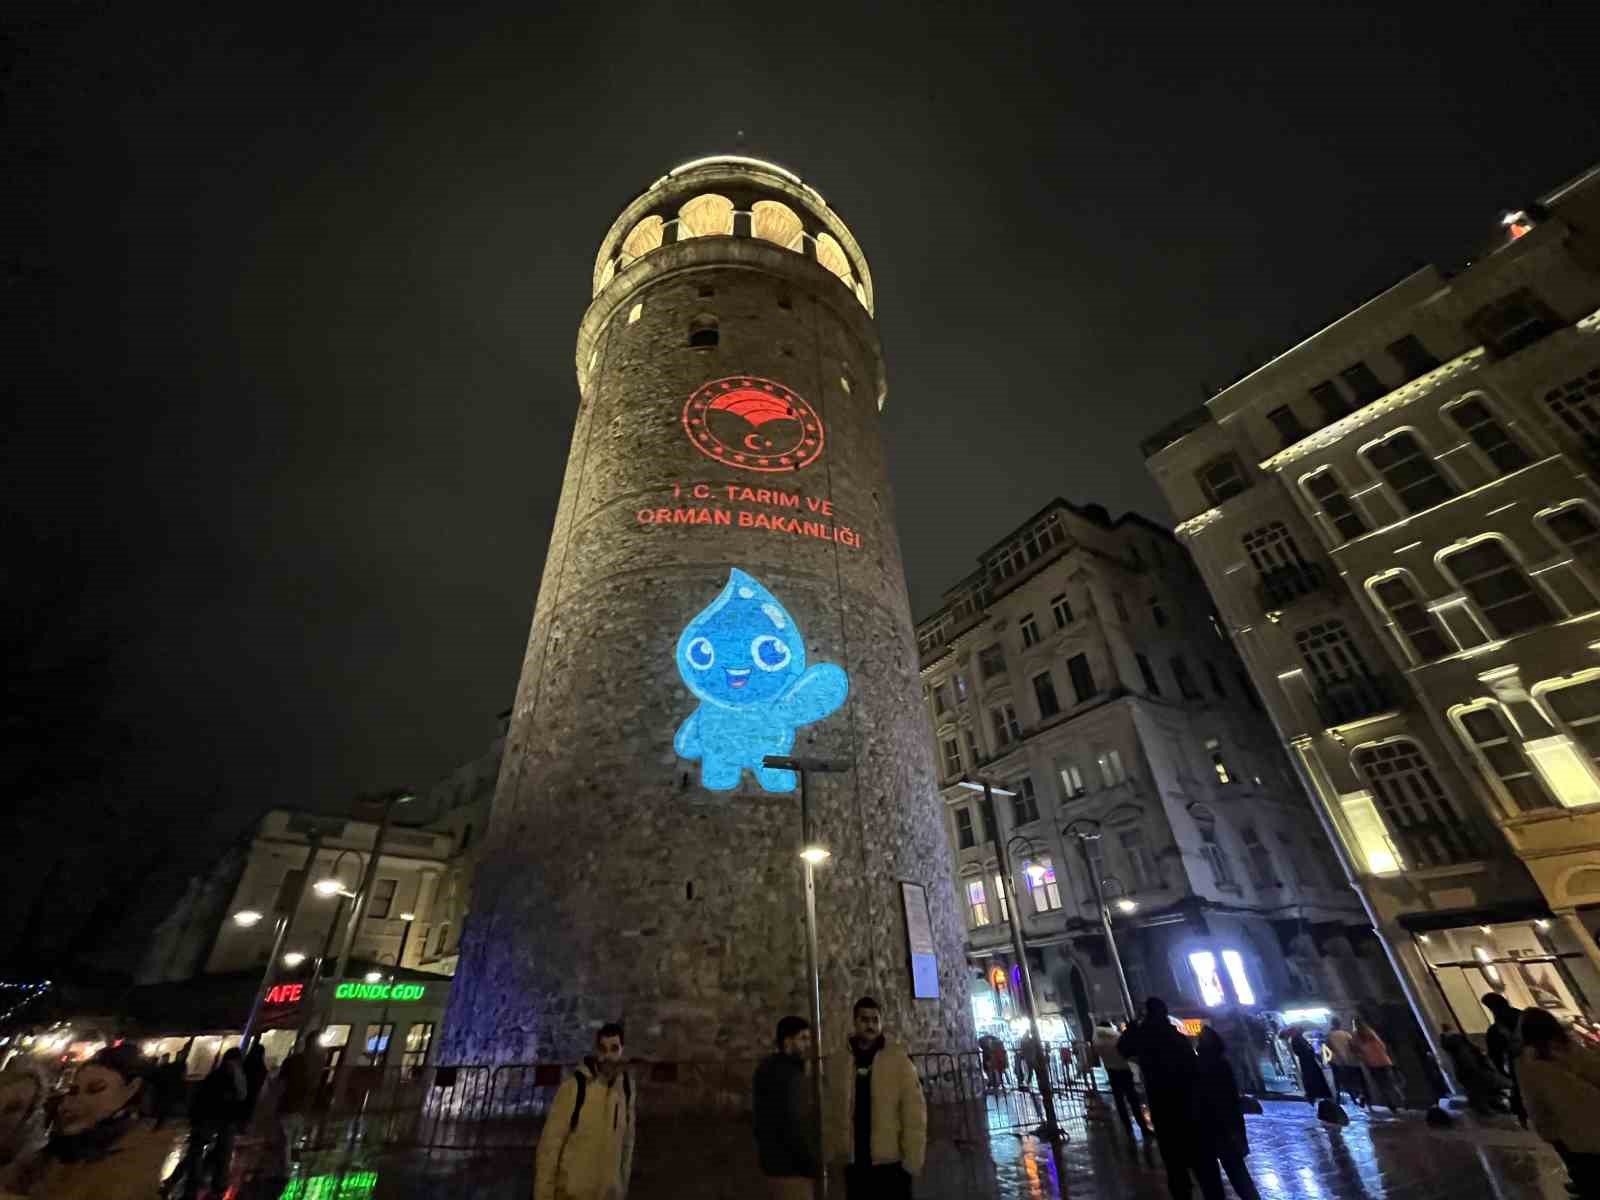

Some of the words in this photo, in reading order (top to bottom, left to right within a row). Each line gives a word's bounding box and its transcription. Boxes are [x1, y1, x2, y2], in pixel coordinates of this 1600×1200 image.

[727, 484, 800, 508] TARIM
[806, 496, 834, 516] VE
[636, 507, 732, 526] ORMAN
[738, 510, 862, 549] BAKANLIĞI
[264, 984, 304, 1003] AFE
